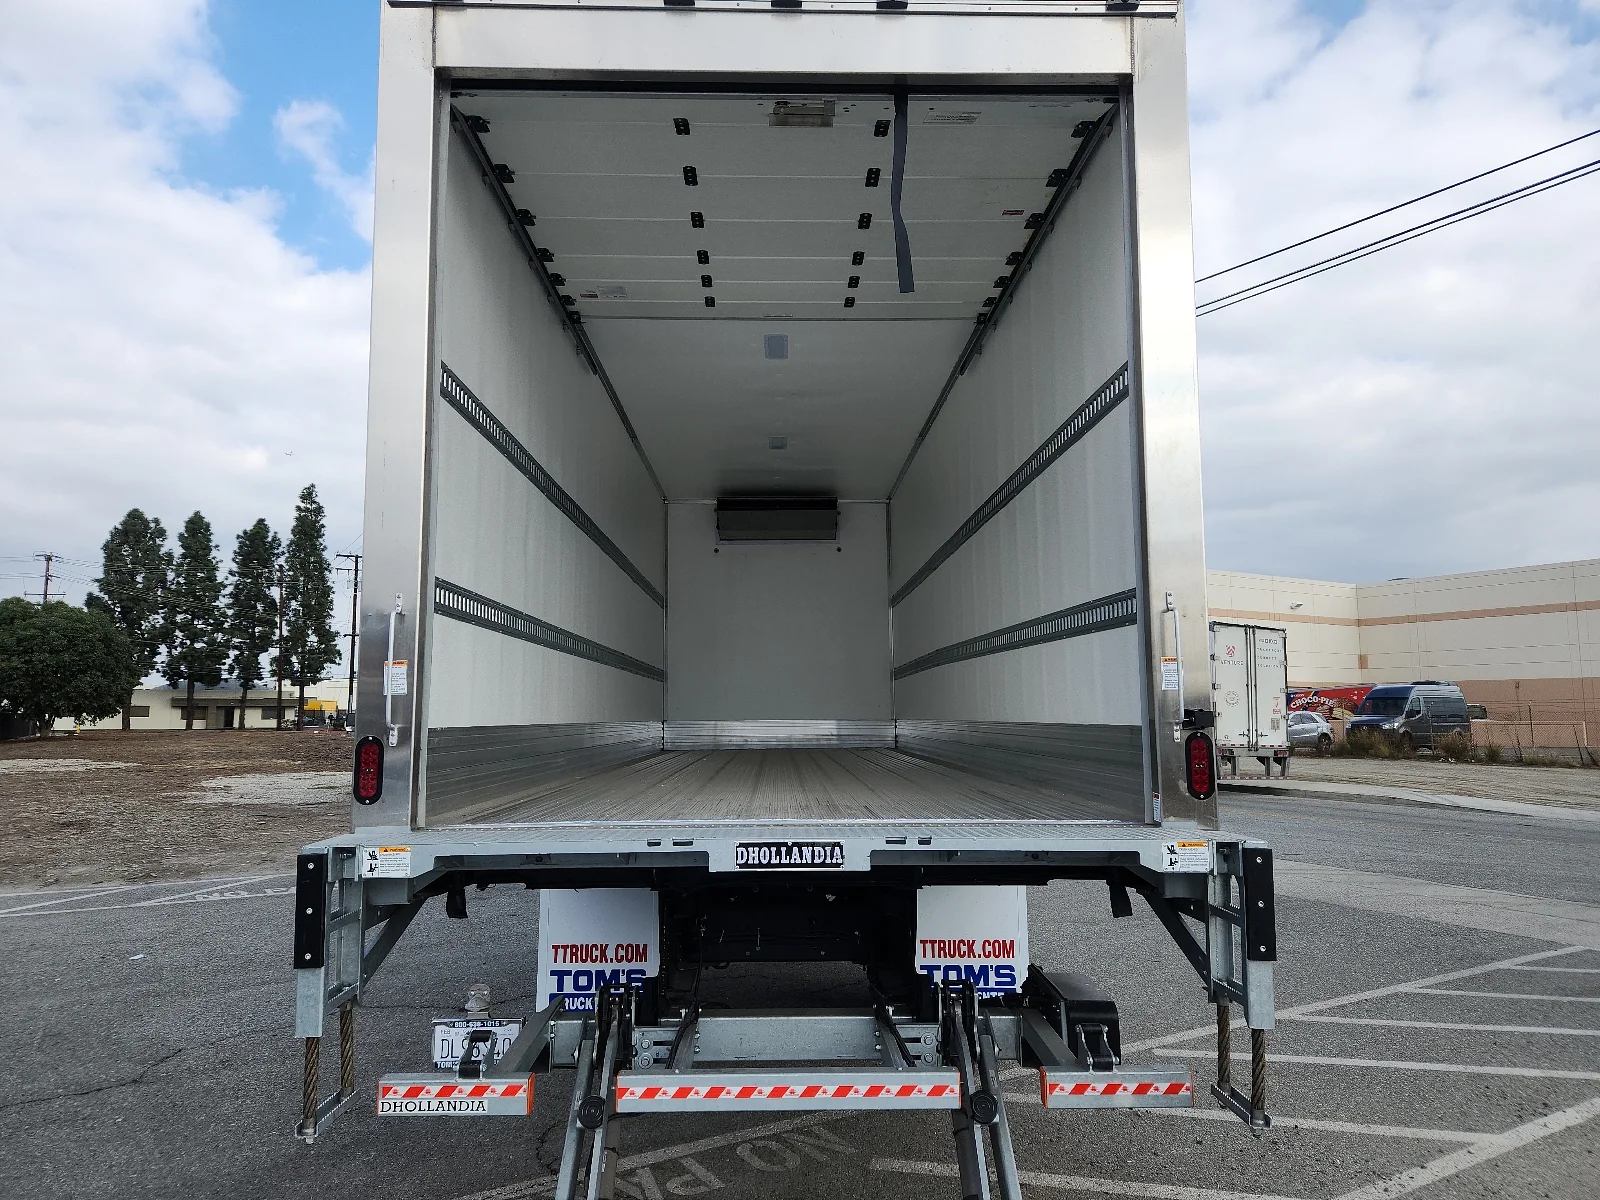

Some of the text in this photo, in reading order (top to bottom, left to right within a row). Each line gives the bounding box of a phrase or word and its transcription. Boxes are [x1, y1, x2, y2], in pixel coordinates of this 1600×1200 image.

[736, 846, 843, 864] DHOLLANDIA
[551, 943, 648, 964] TTRUCK.COM
[920, 938, 1016, 959] TTRUCK.COM
[549, 968, 647, 993] TOM'S
[919, 964, 1017, 987] TOM'S
[380, 1100, 487, 1113] DHOLLANDIA
